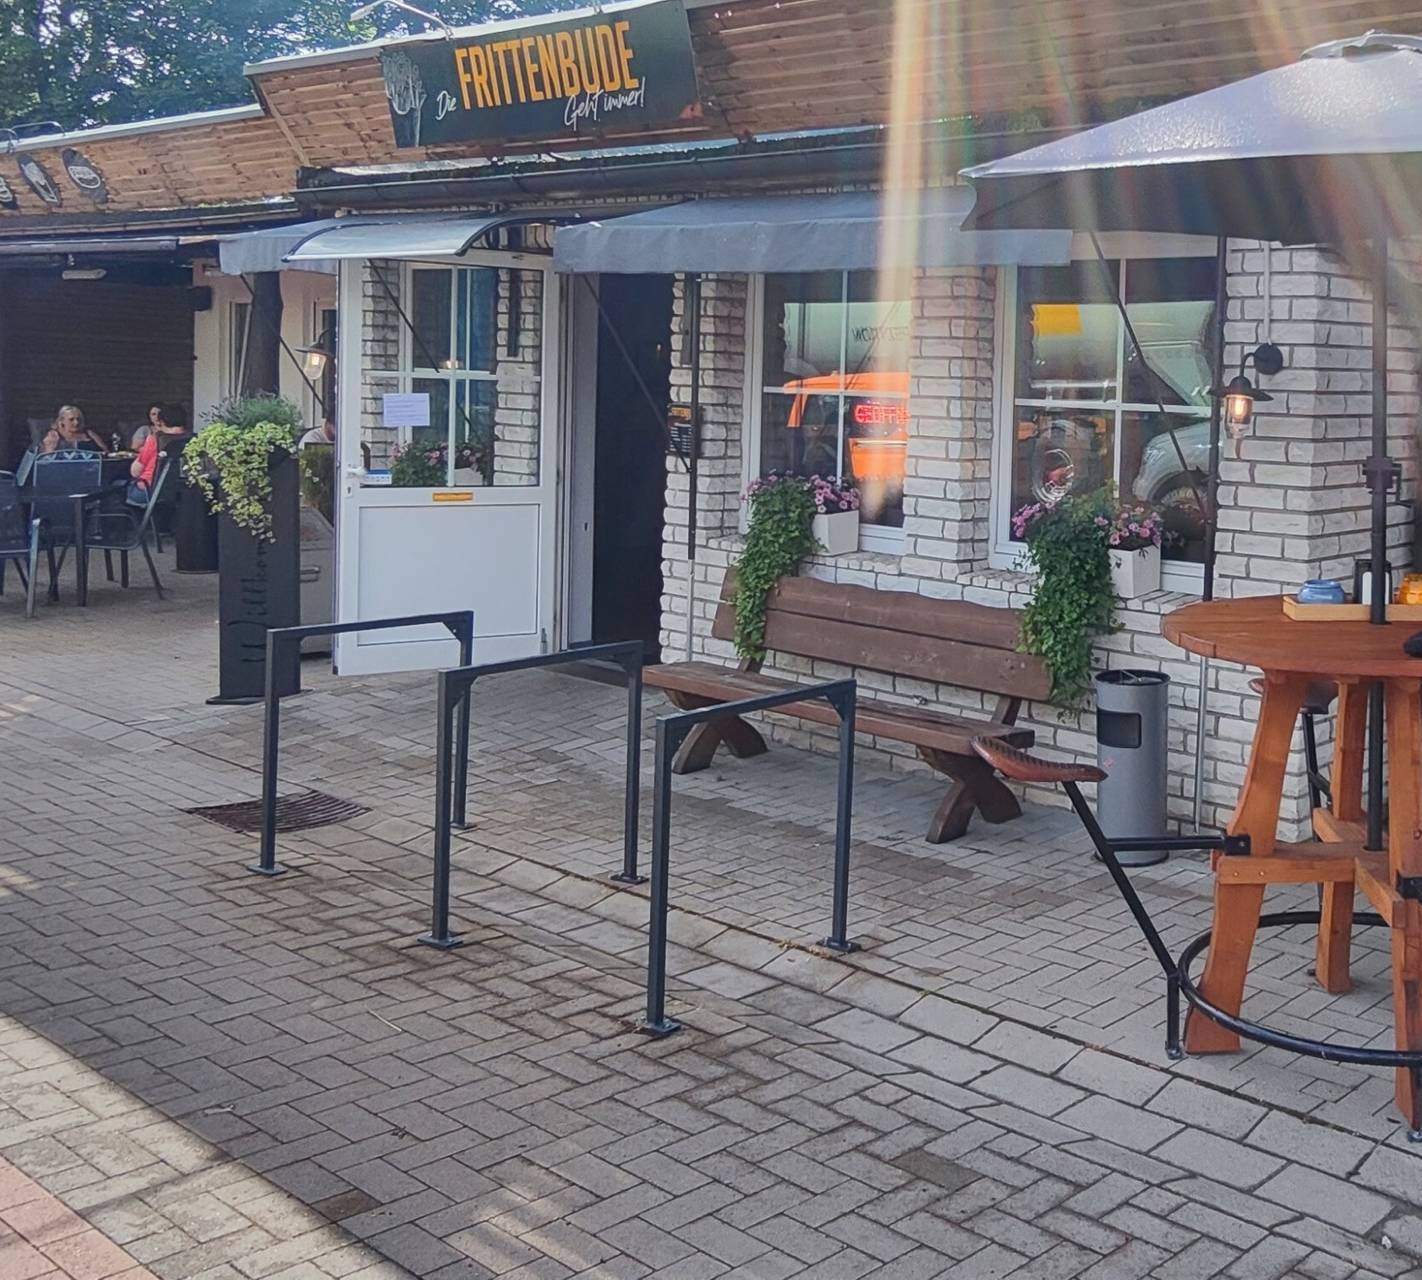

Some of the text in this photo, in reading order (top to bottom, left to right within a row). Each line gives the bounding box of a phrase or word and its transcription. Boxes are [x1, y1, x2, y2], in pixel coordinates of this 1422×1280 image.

[435, 21, 640, 121] Die FRITTENBUDE
[564, 89, 604, 131] Geht
